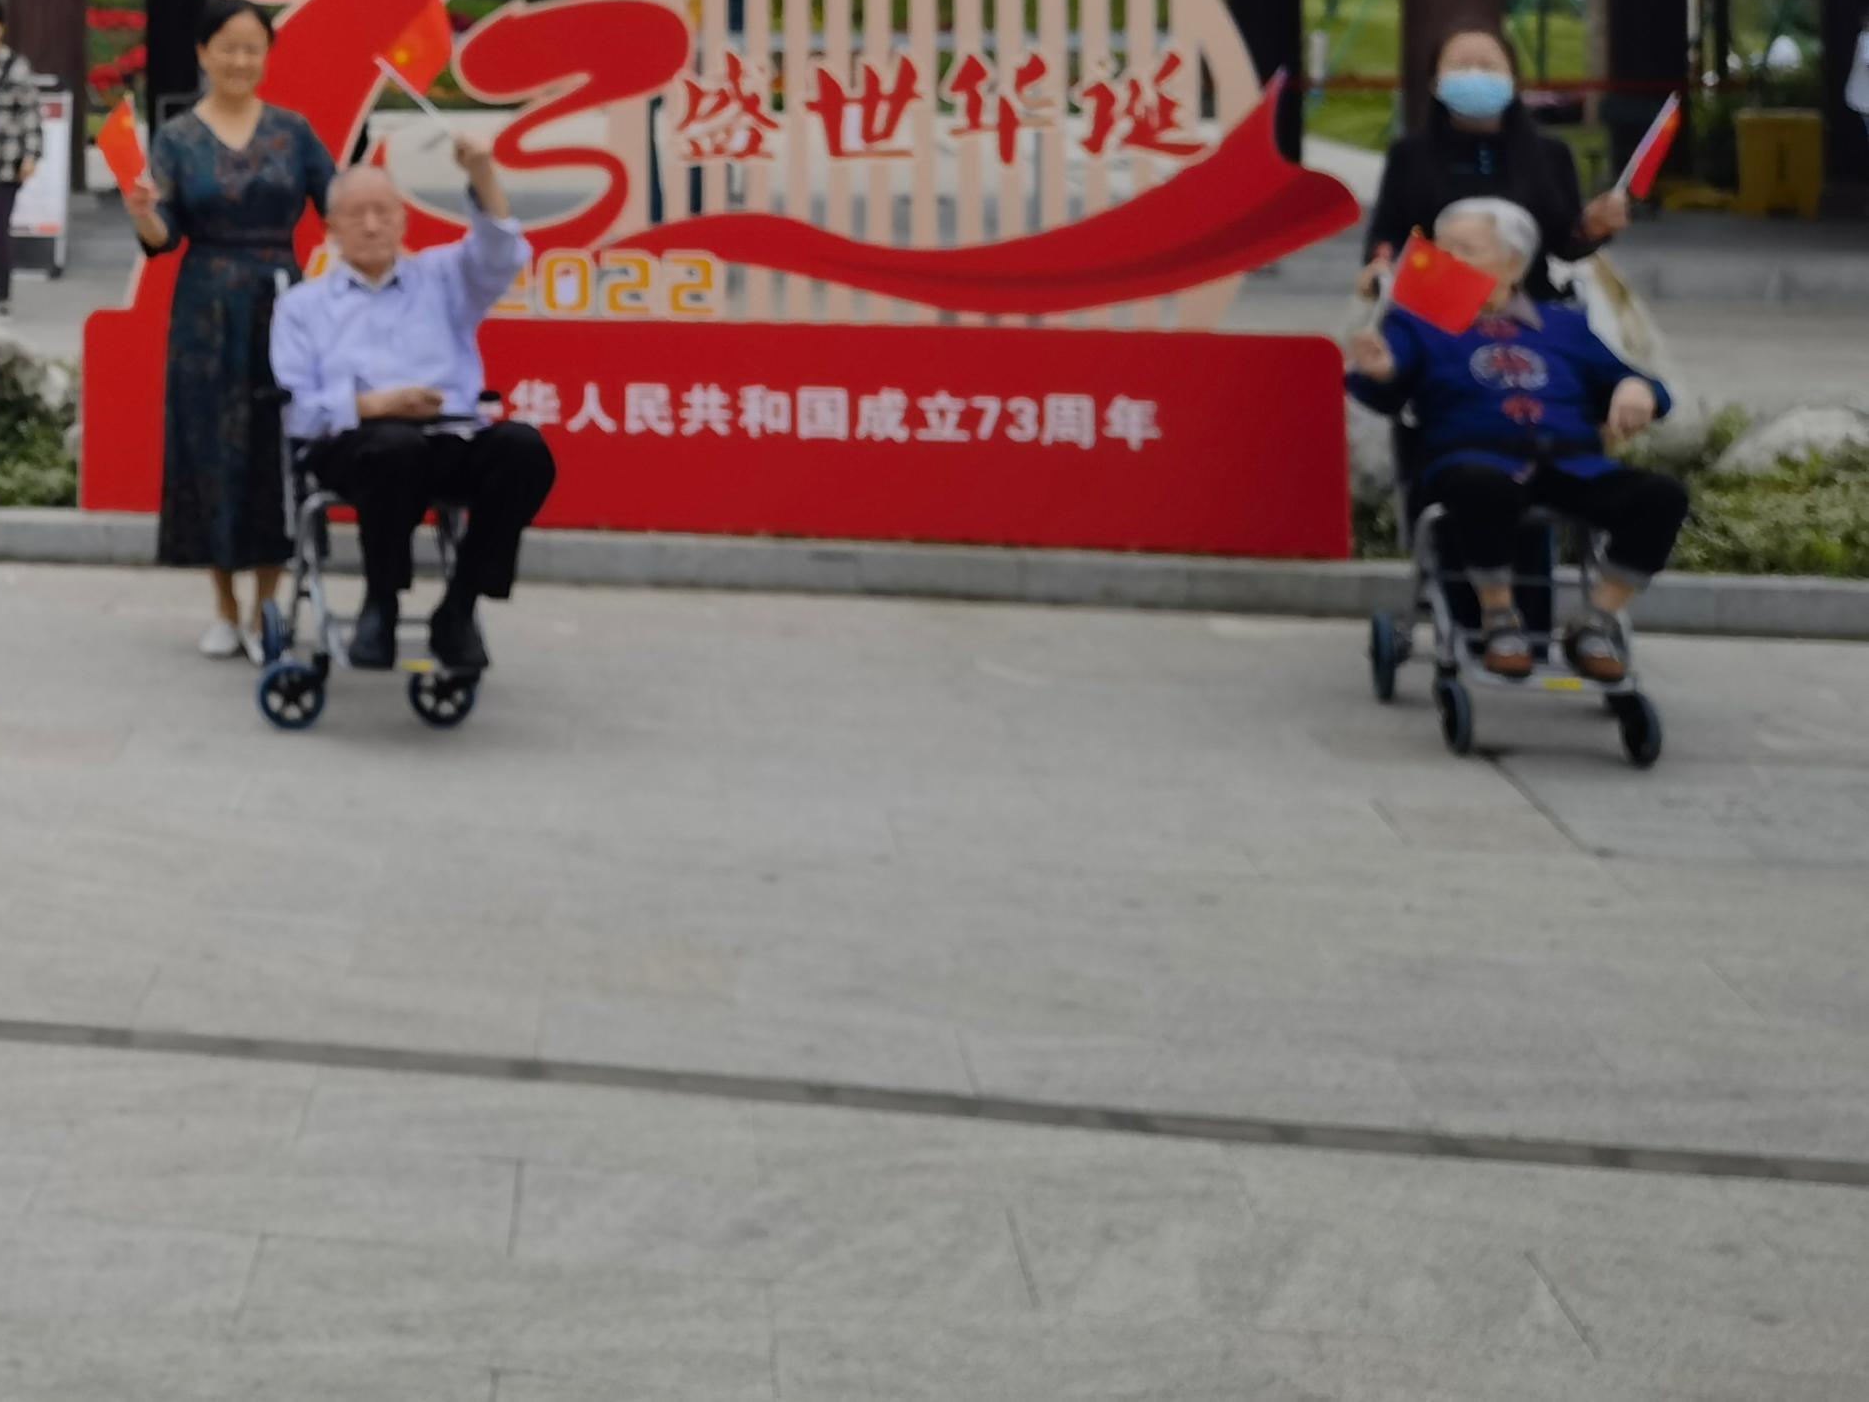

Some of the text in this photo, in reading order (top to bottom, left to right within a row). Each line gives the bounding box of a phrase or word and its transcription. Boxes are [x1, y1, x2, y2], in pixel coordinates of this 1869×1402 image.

[676, 51, 1211, 165] 盛世华诞
[477, 378, 1162, 451] 华人民共和国成立73周年
